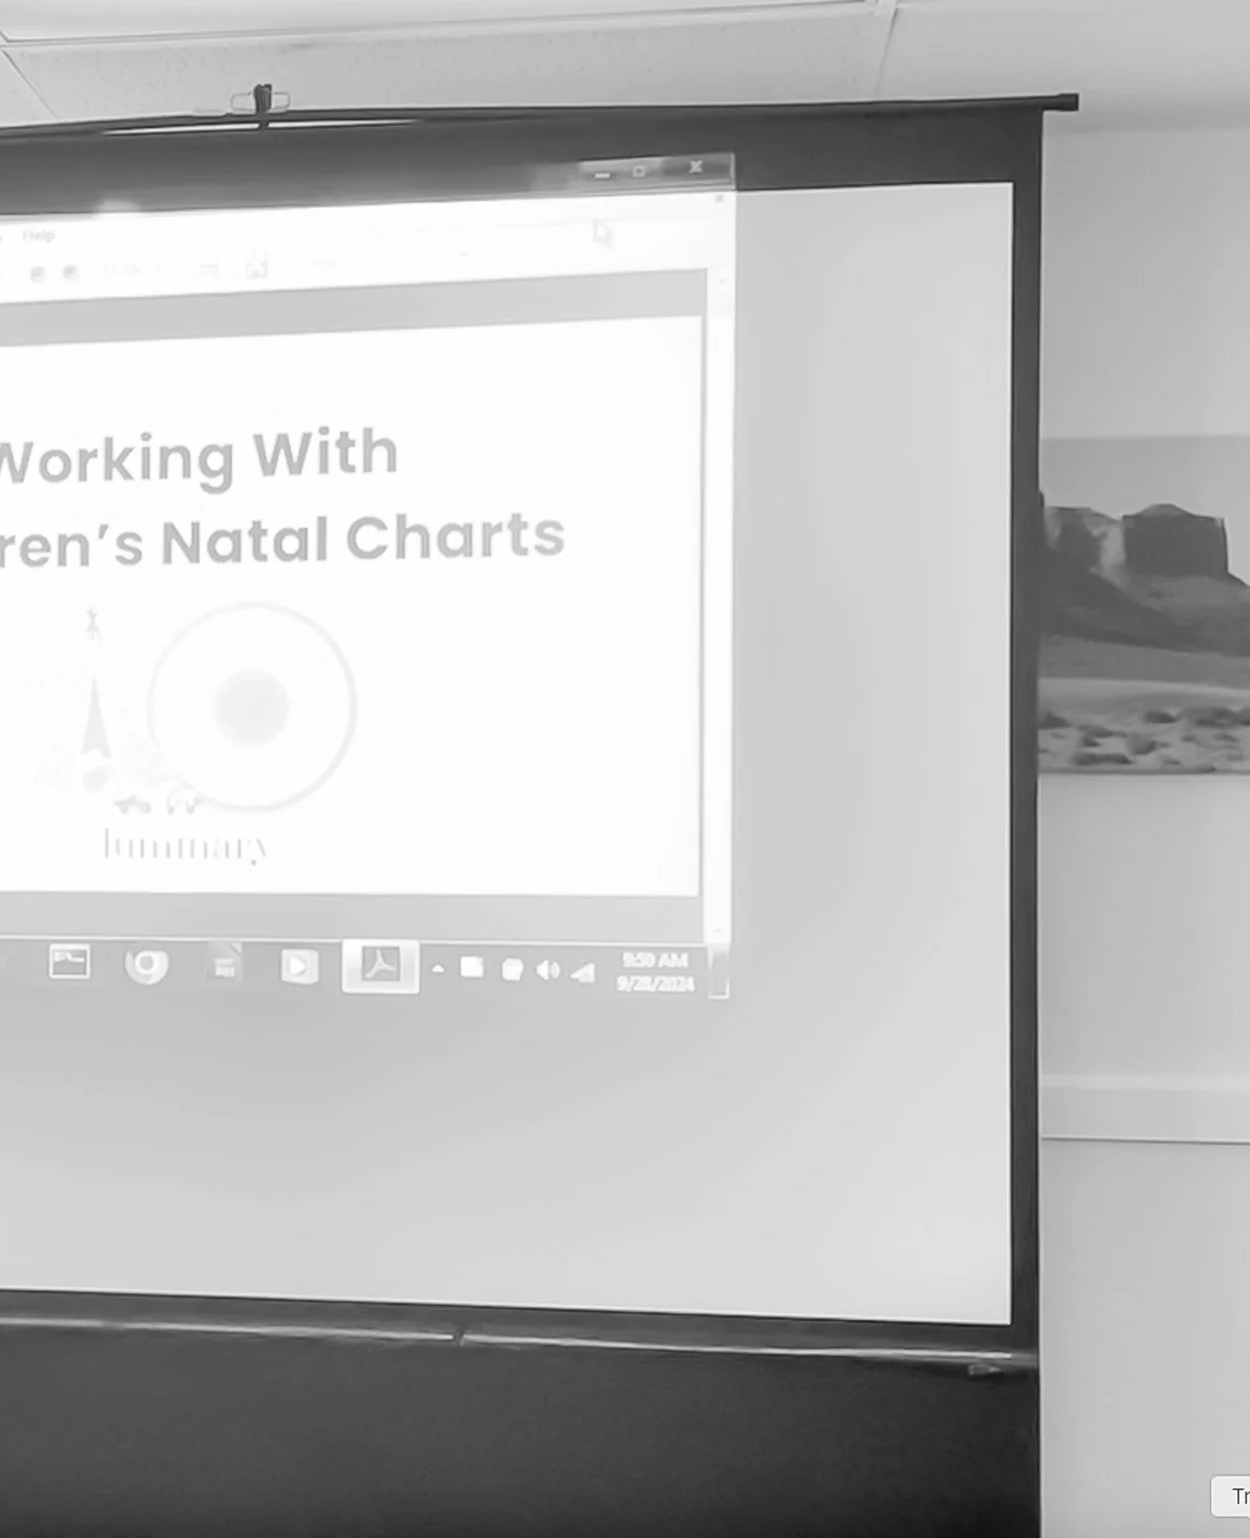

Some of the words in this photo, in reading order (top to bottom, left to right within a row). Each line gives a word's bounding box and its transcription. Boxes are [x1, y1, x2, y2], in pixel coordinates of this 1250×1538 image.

[21, 228, 55, 244] Help
[252, 425, 397, 477] With
[162, 515, 328, 565] Natal
[346, 512, 564, 560] Charts
[104, 828, 267, 867] luminary
[657, 952, 689, 968] AM
